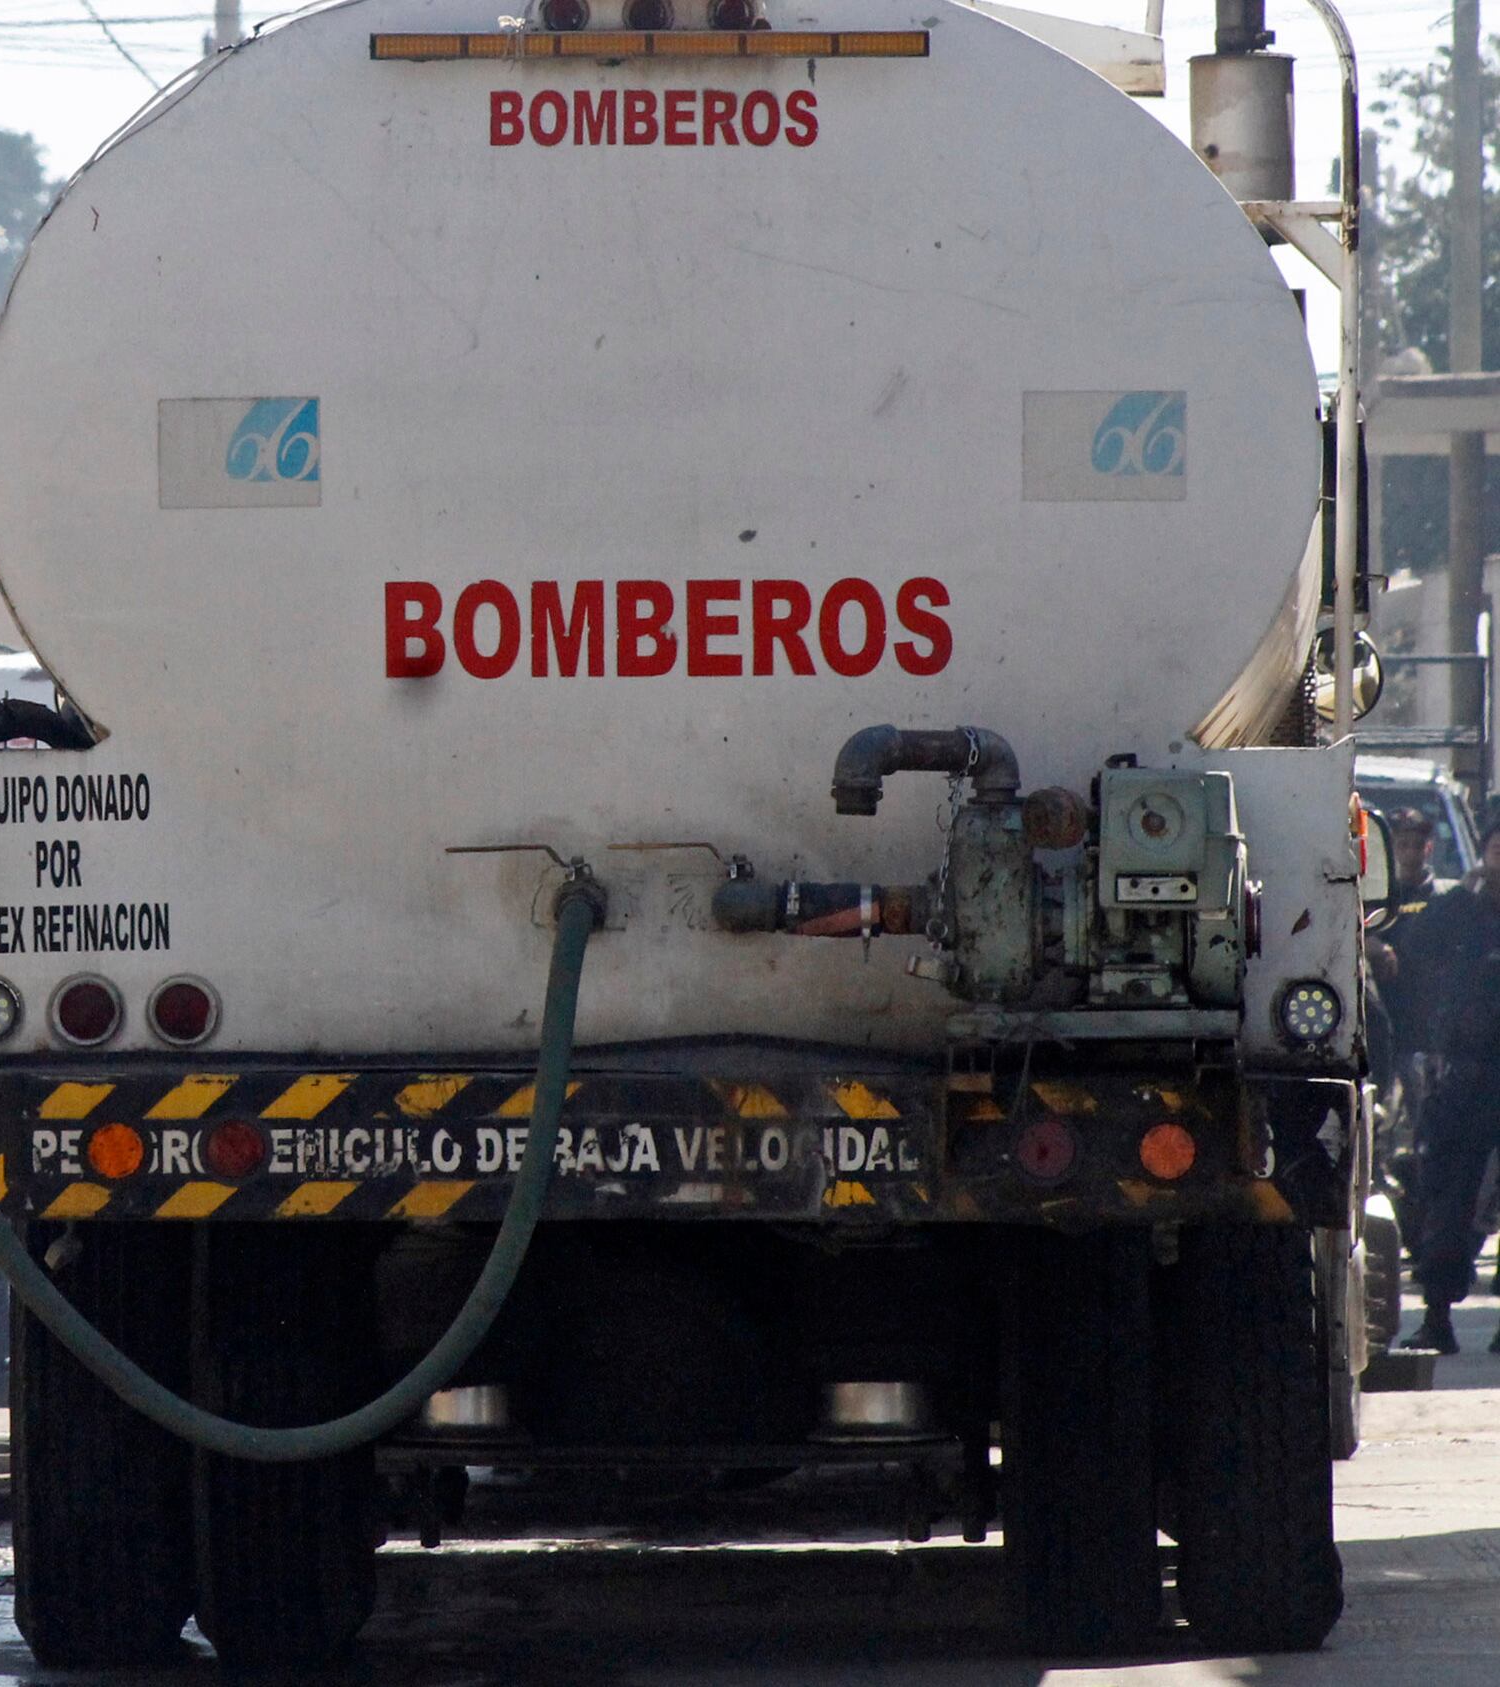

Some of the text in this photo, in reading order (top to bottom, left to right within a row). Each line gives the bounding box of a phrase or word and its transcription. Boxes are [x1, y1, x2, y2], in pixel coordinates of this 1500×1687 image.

[489, 89, 819, 147] BOMBEROS
[384, 577, 953, 679] BOMBEROS
[56, 773, 150, 822] DONADO
[36, 839, 82, 888] POR
[33, 902, 170, 953] REFINACION
[476, 1127, 531, 1173] DE
